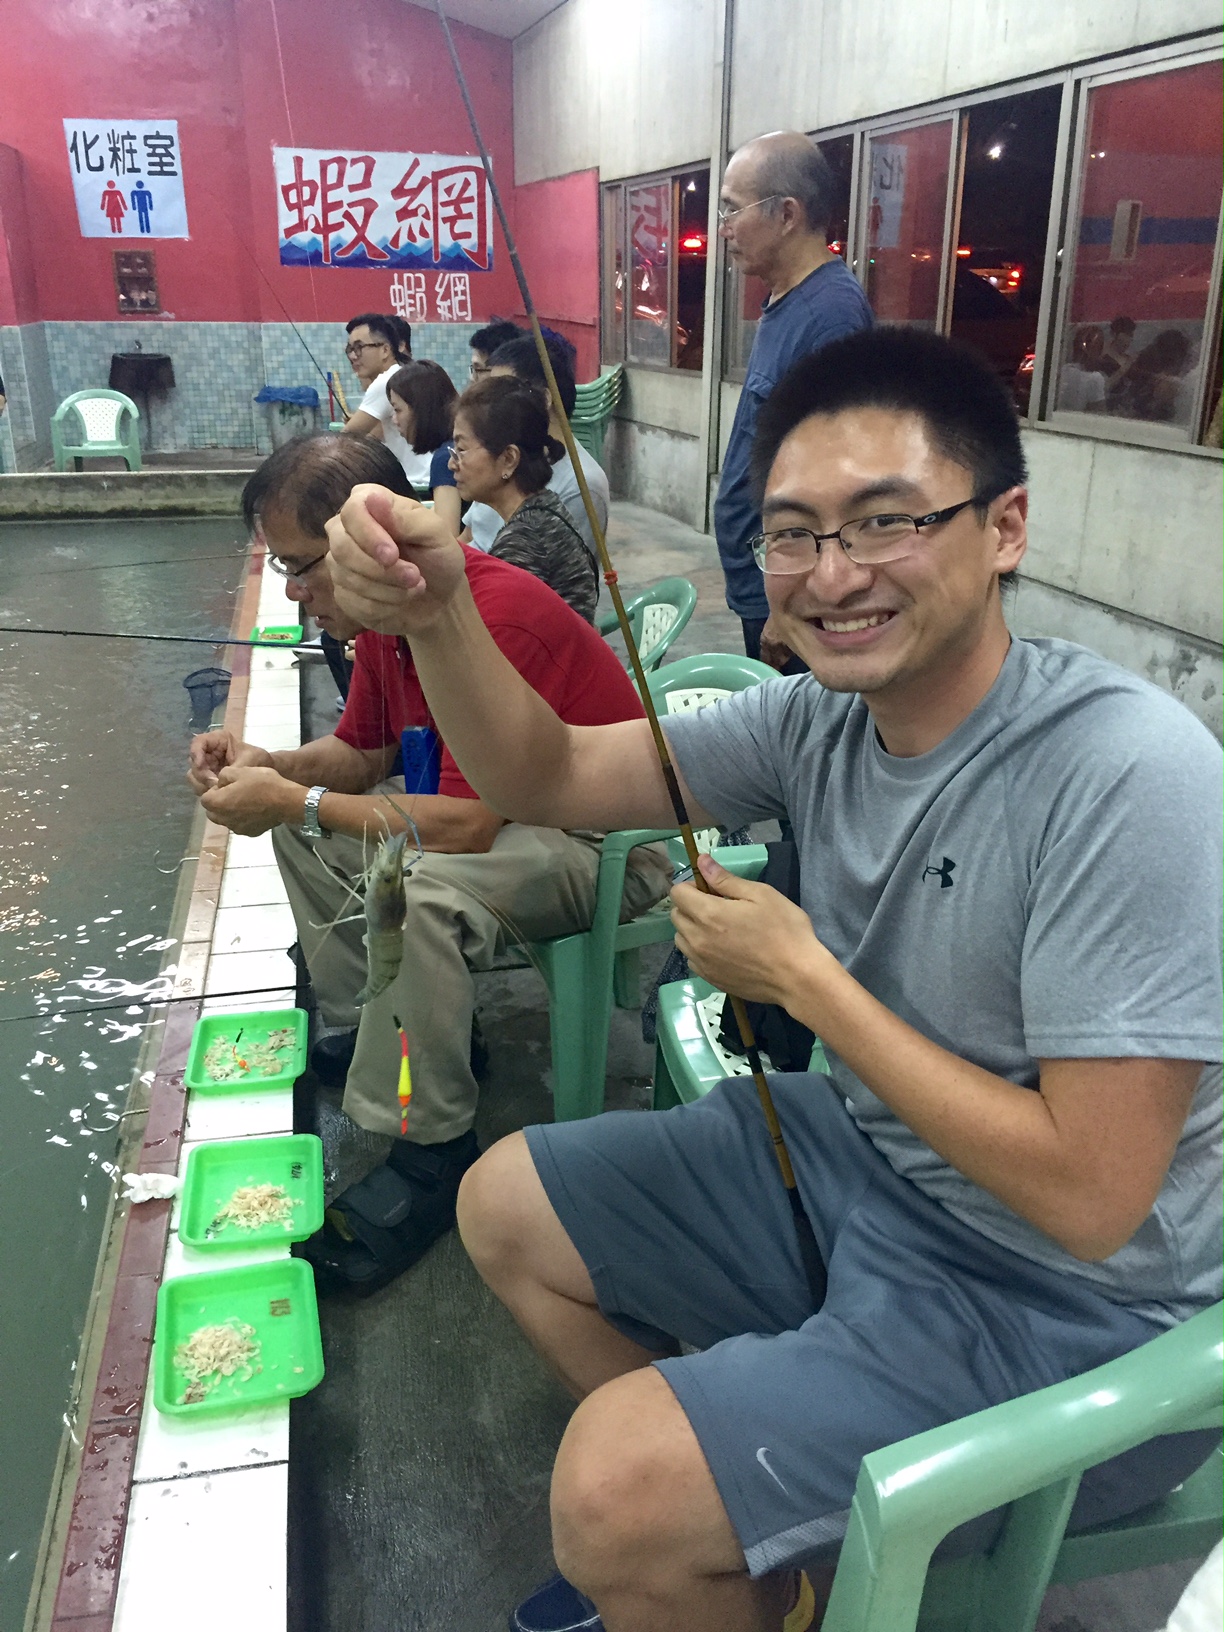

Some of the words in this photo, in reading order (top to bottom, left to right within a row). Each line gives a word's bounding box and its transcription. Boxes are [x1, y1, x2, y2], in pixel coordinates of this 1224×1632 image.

[69, 128, 178, 177] 化粧室
[281, 155, 489, 270] 蝦網
[389, 272, 472, 322] 蝦網
